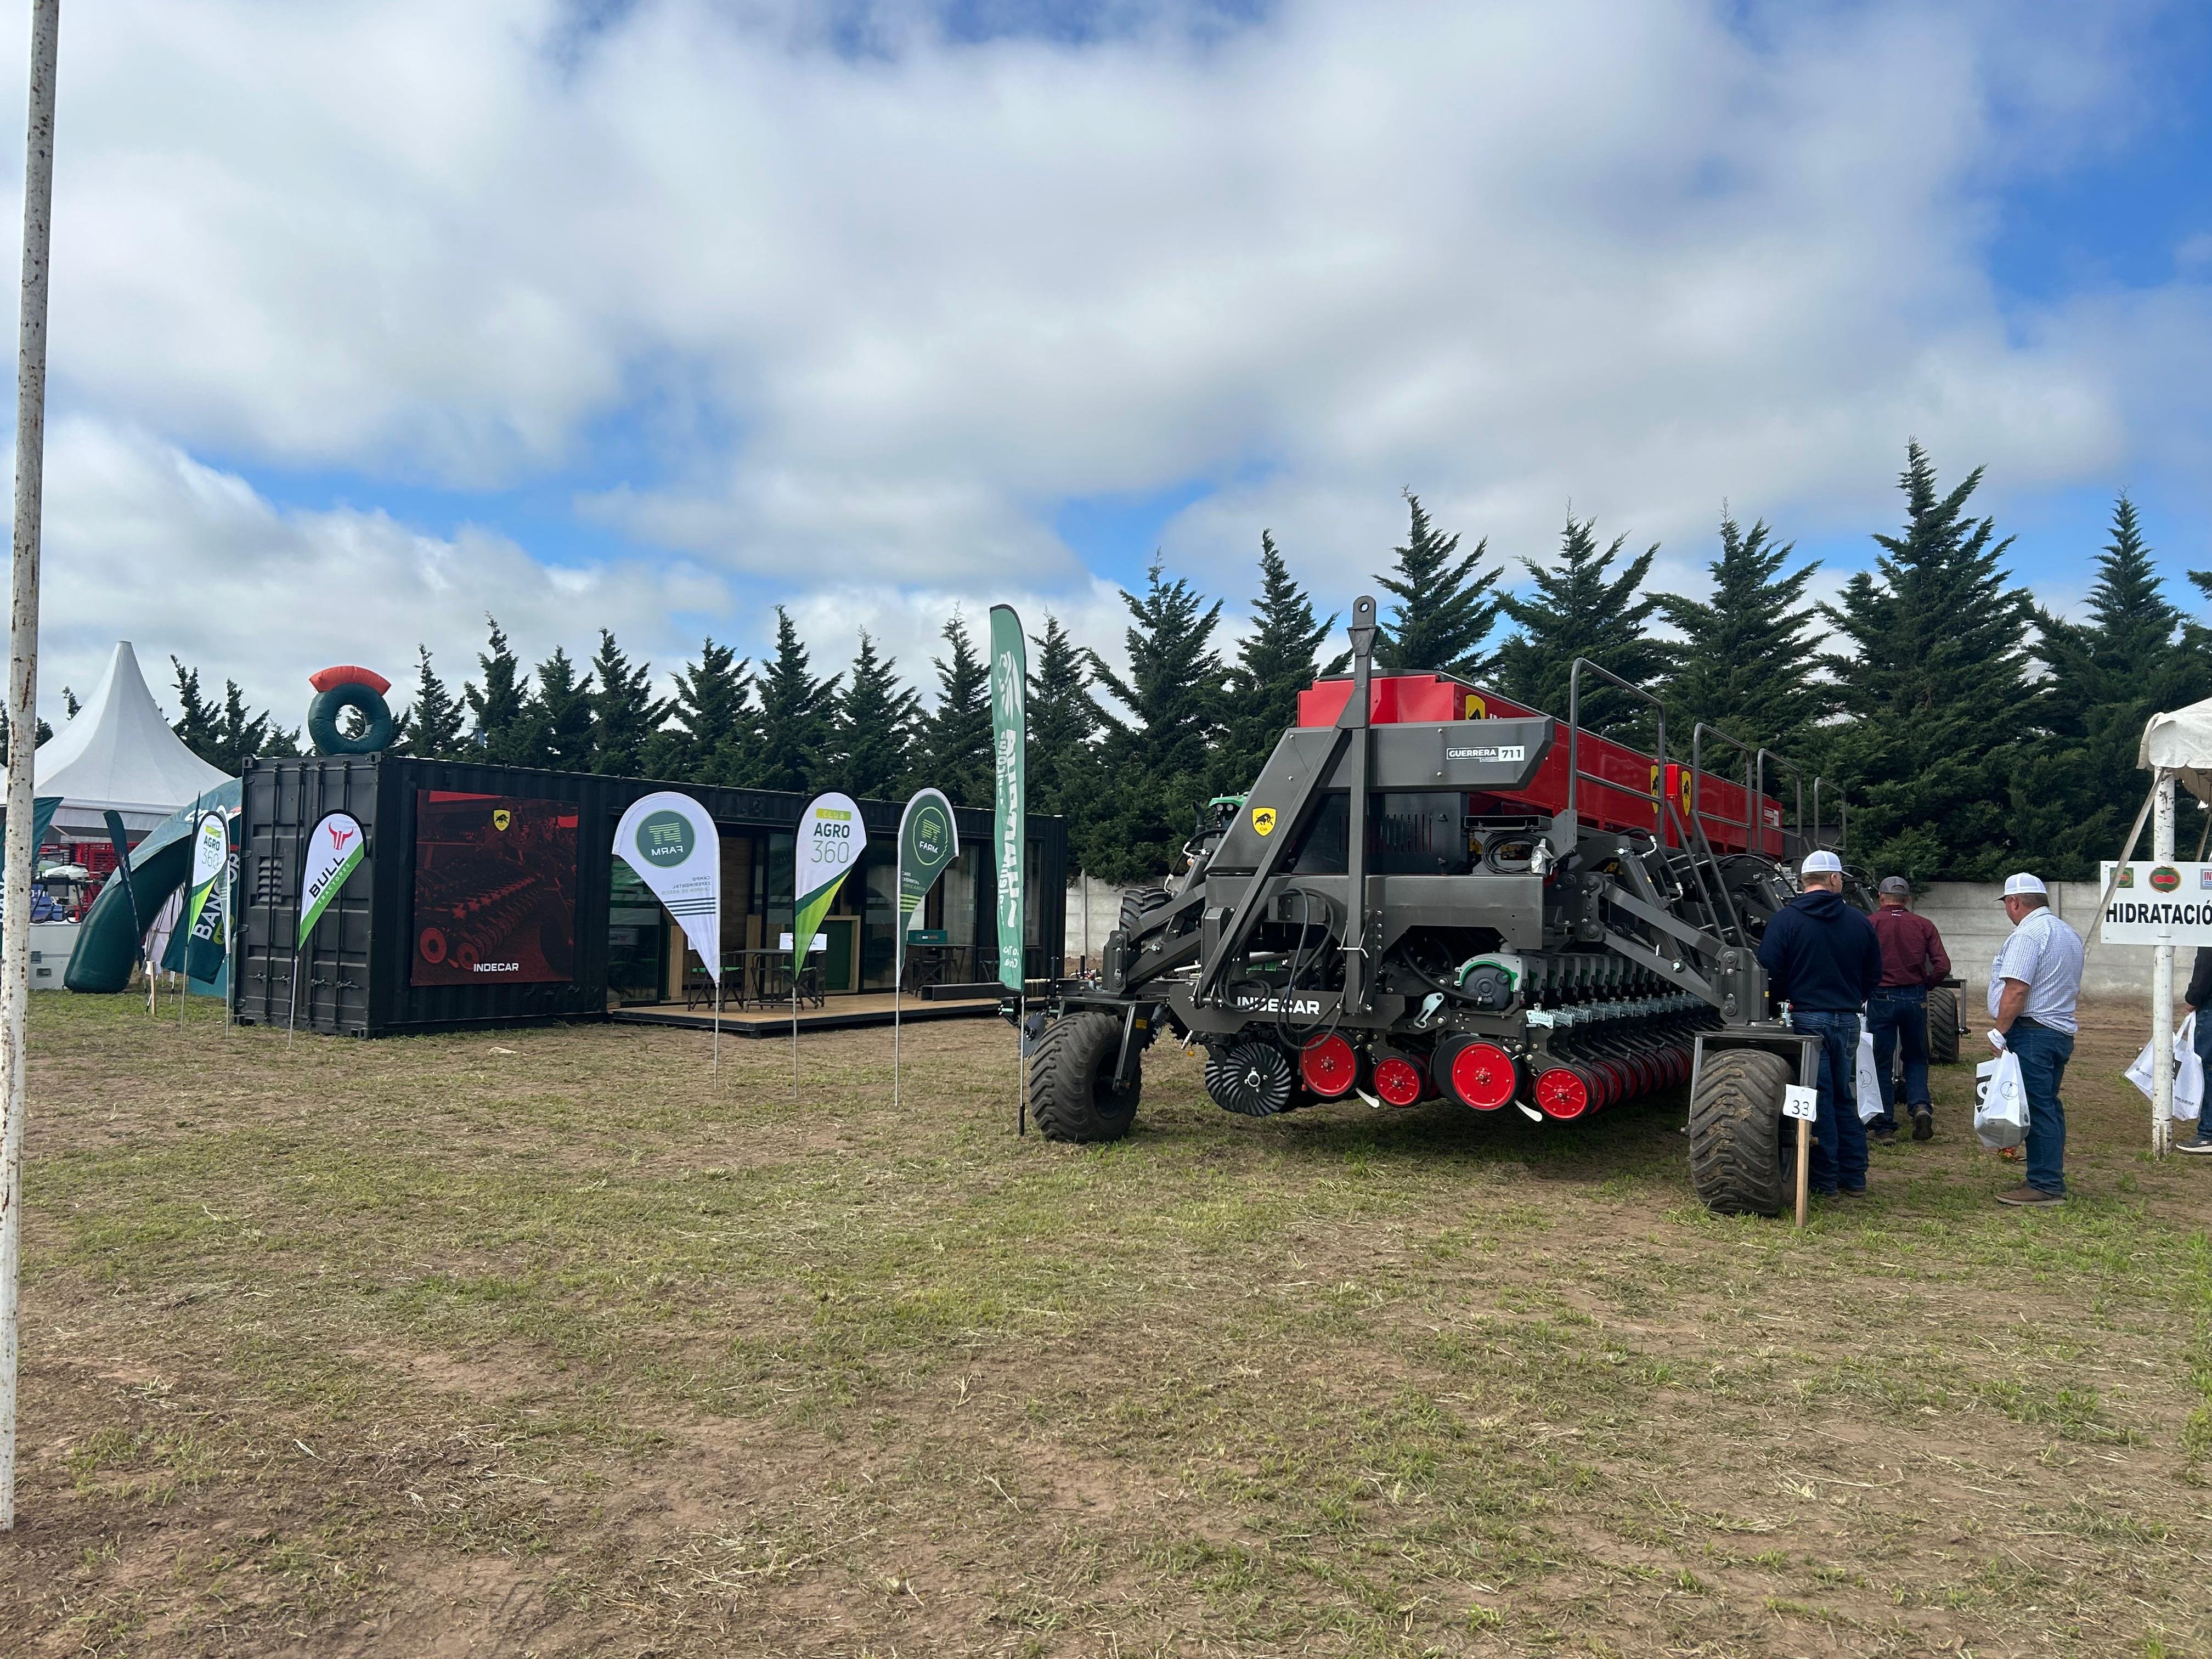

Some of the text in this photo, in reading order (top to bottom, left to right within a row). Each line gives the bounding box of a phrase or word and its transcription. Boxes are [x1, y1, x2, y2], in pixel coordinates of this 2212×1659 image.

[1449, 749, 1521, 758] GUERRERA 711
[823, 810, 845, 820] CLUB
[814, 822, 850, 838] AGRO
[204, 836, 220, 851] AGRO
[201, 848, 220, 869] 360
[811, 840, 850, 864] 360
[309, 857, 345, 898] BULL
[318, 862, 350, 905] TRACTORES
[473, 962, 519, 972] INDECAR
[1792, 1100, 1809, 1116] 33
